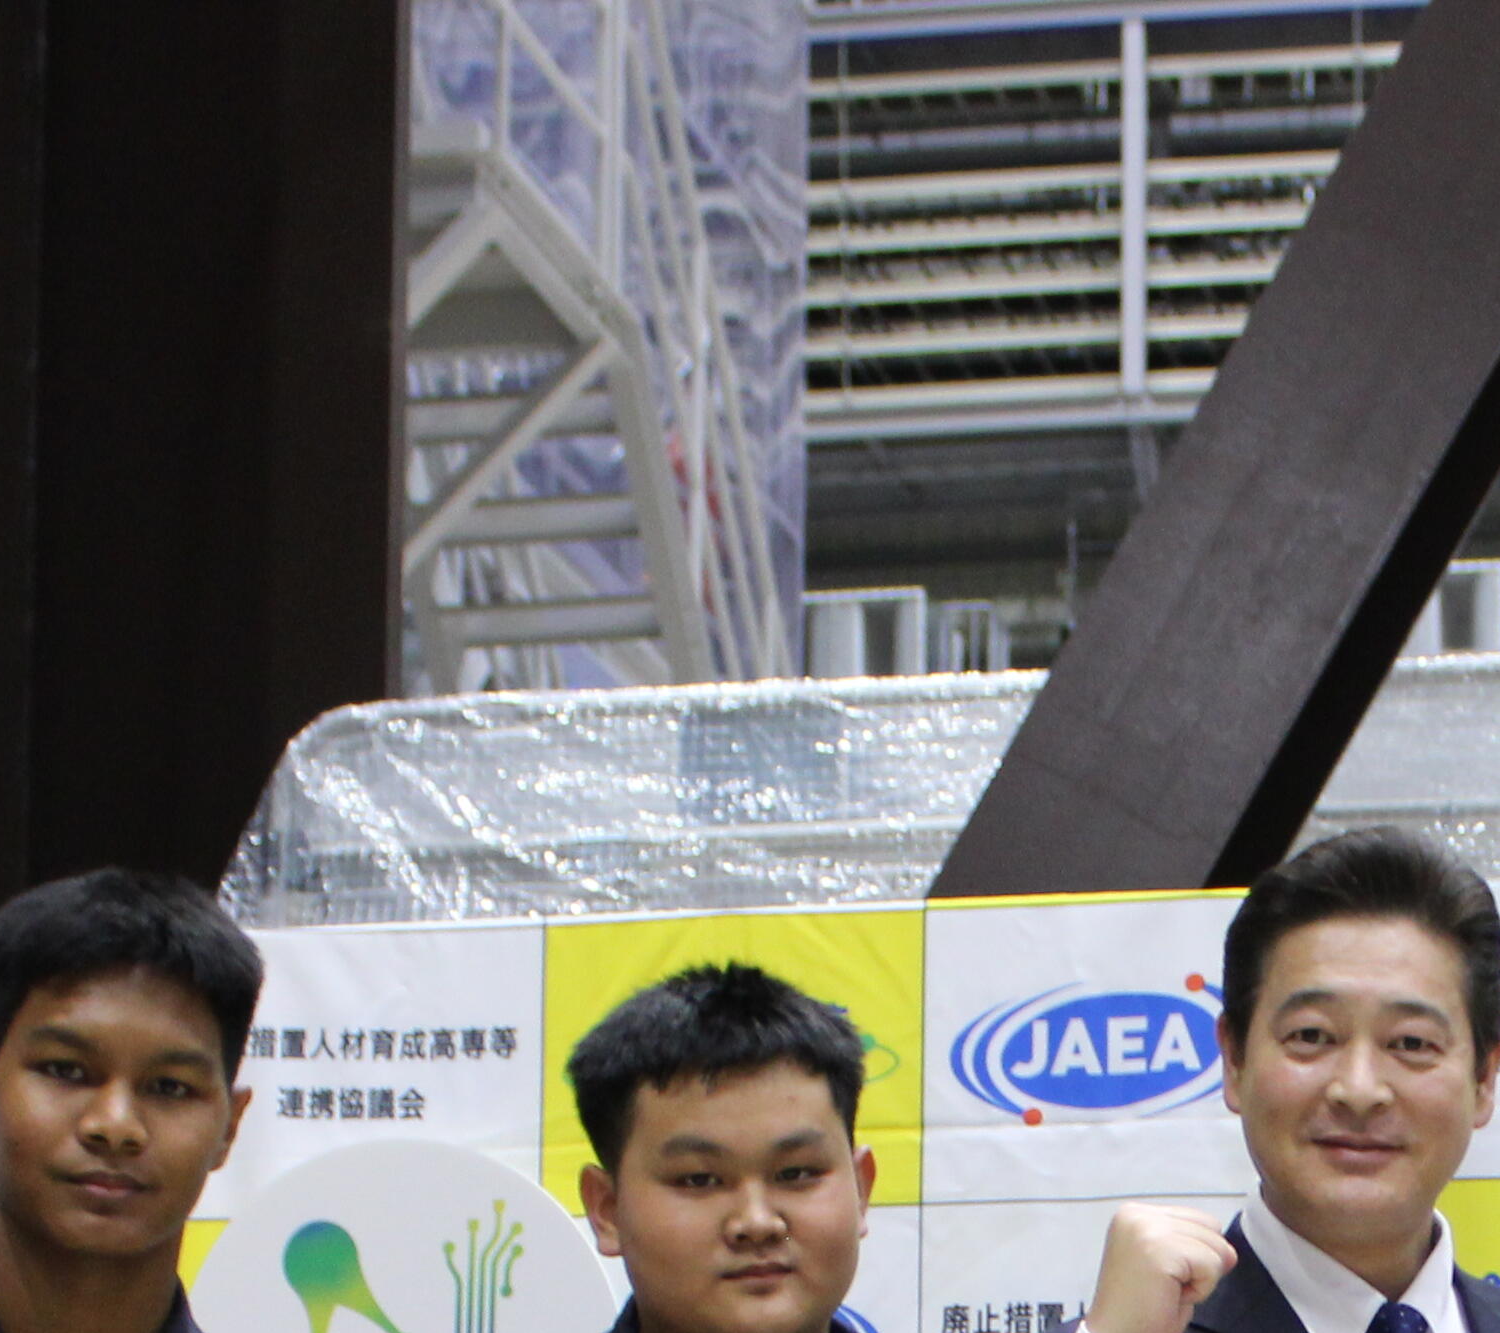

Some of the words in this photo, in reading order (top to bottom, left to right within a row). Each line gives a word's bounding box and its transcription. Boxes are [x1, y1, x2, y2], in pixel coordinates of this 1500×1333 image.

[1010, 1012, 1201, 1079] JAEA
[277, 1086, 426, 1120] 連携協議会
